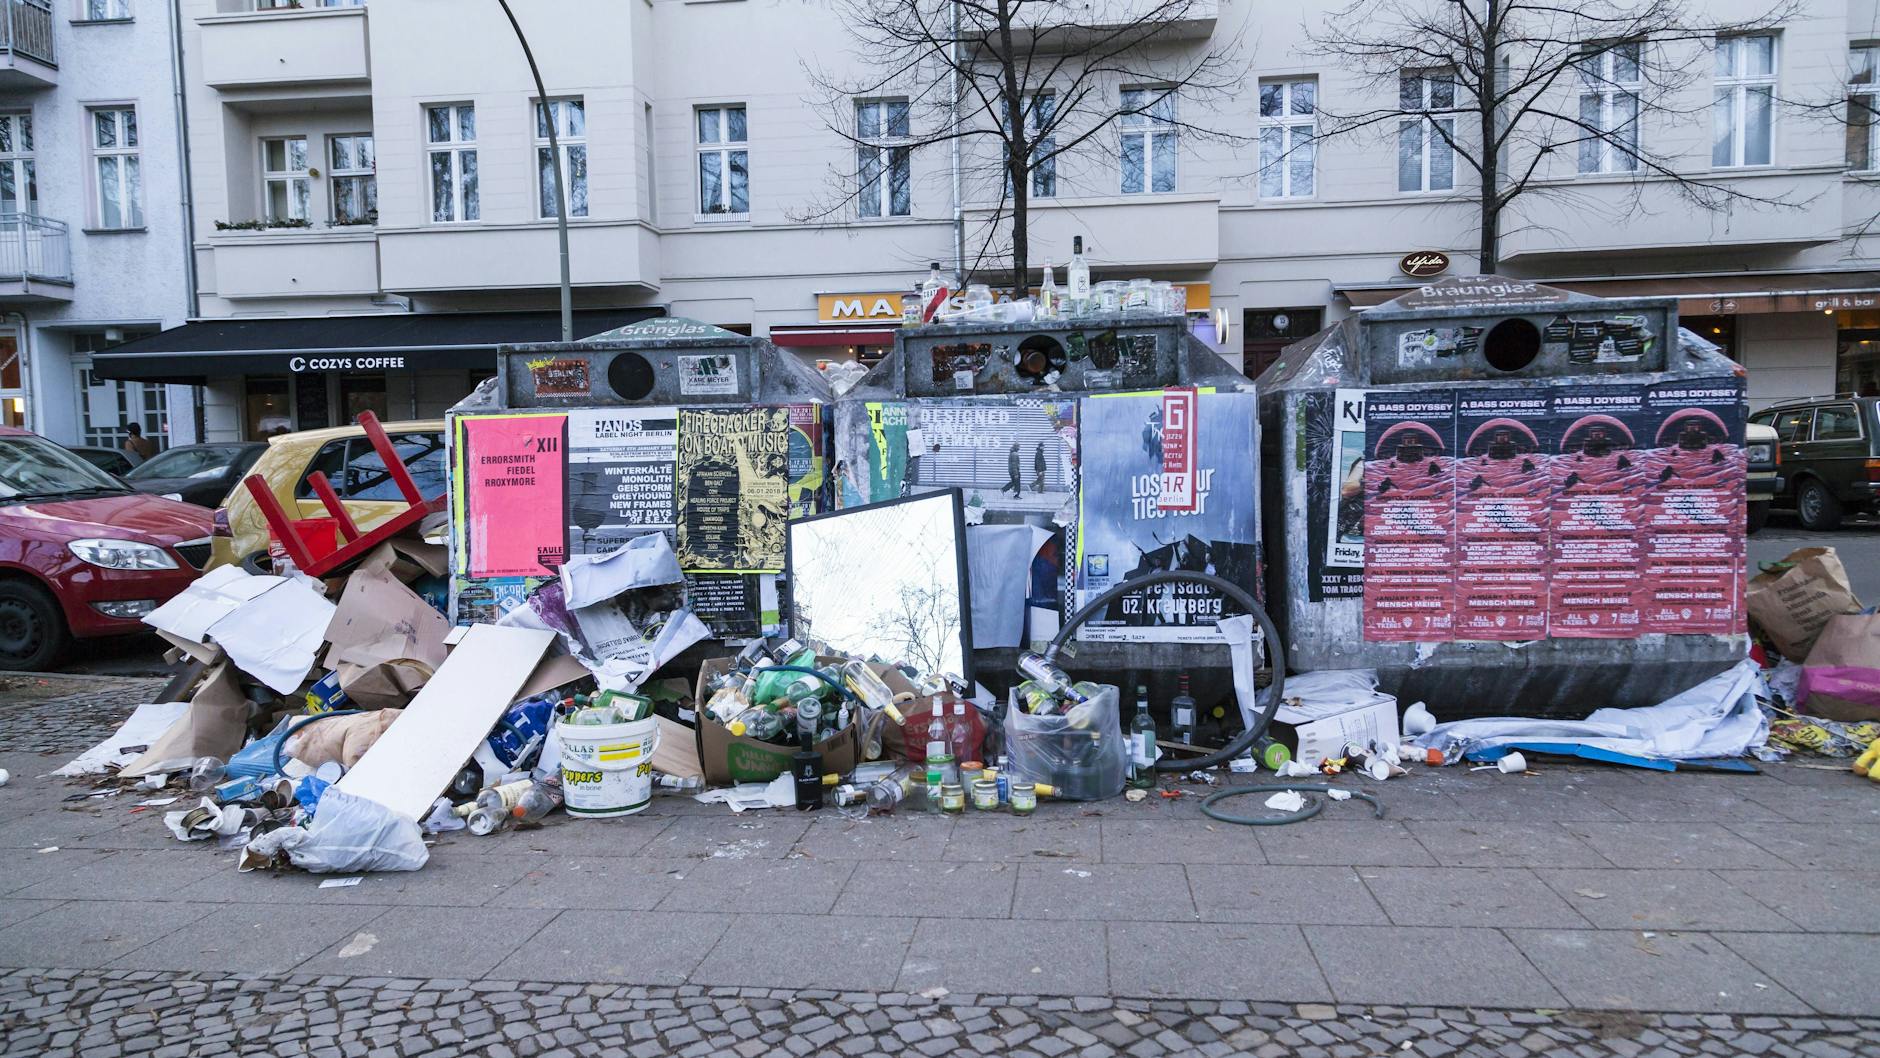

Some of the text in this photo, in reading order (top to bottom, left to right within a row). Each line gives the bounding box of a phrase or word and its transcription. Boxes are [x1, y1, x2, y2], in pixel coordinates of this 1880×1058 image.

[1420, 282, 1537, 298] Braunglas
[1815, 297, 1839, 310] grill
[620, 323, 706, 337] Grünglas
[309, 358, 352, 369] COZYS
[355, 357, 405, 369] COFFEE
[1659, 390, 1687, 398] BASS
[1689, 389, 1738, 397] ODYSSEY
[1471, 400, 1497, 408] BASS
[1593, 396, 1643, 404] ODYSSEY
[1406, 403, 1453, 411] ODYSSEY
[684, 411, 767, 434] FIRECRACKER
[595, 431, 619, 439] LABEL
[537, 437, 558, 453] XII
[684, 434, 701, 454] ON
[746, 432, 788, 454] MUSIC
[480, 455, 536, 465] ERRORSMITH
[506, 466, 536, 475] FIEDEL
[604, 465, 673, 476] WINTERKÄLTE
[484, 477, 536, 488] RROXYMORE
[621, 475, 672, 484] MONOLITH
[617, 483, 672, 493] GEISTFORM
[612, 492, 672, 501] GREYHOUND
[609, 500, 672, 509] NEW FRAMES
[619, 509, 672, 517] LAST DAYS
[644, 516, 672, 524] S.E.X.
[494, 584, 527, 601] ENCORE
[1321, 585, 1339, 594] TOM
